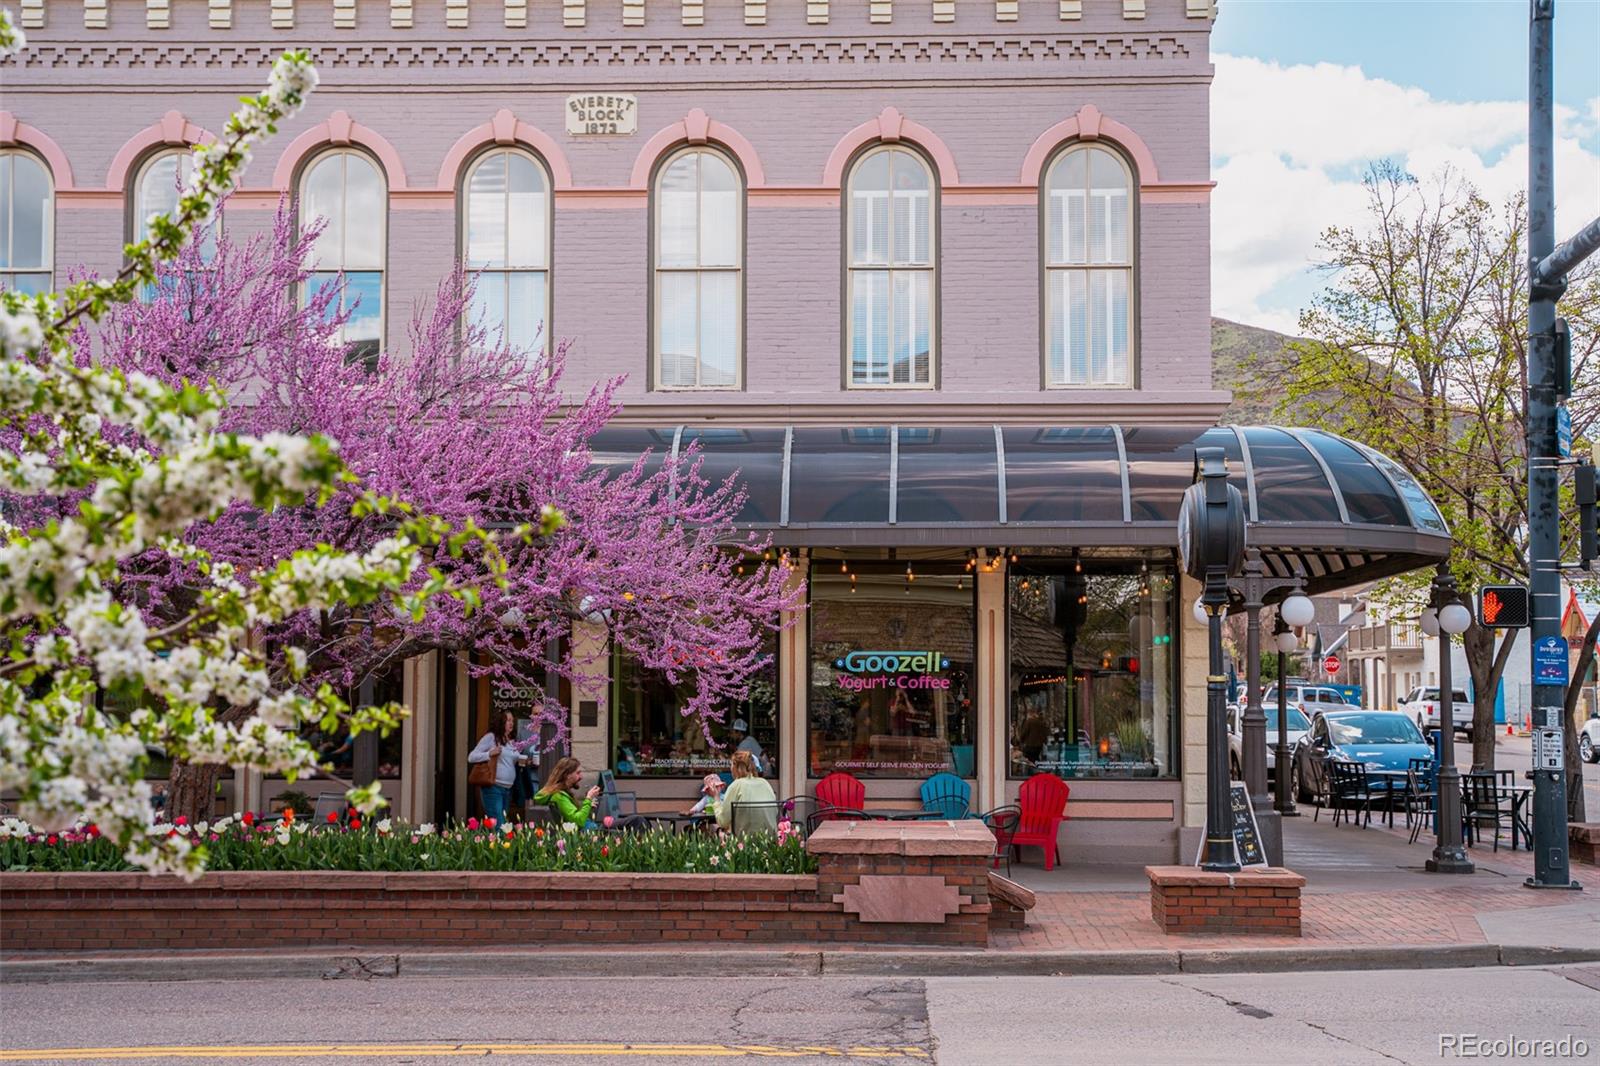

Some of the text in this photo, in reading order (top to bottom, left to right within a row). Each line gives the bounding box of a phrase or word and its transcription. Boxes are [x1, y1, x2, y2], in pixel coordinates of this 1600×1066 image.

[569, 96, 634, 112] EVERETT
[578, 109, 624, 121] BLOCK
[585, 123, 617, 134] 1873
[845, 651, 941, 672] Goozell
[1324, 661, 1340, 669] STOP
[836, 675, 951, 692] Yogurt & Coffee
[493, 700, 521, 710] Yogurt
